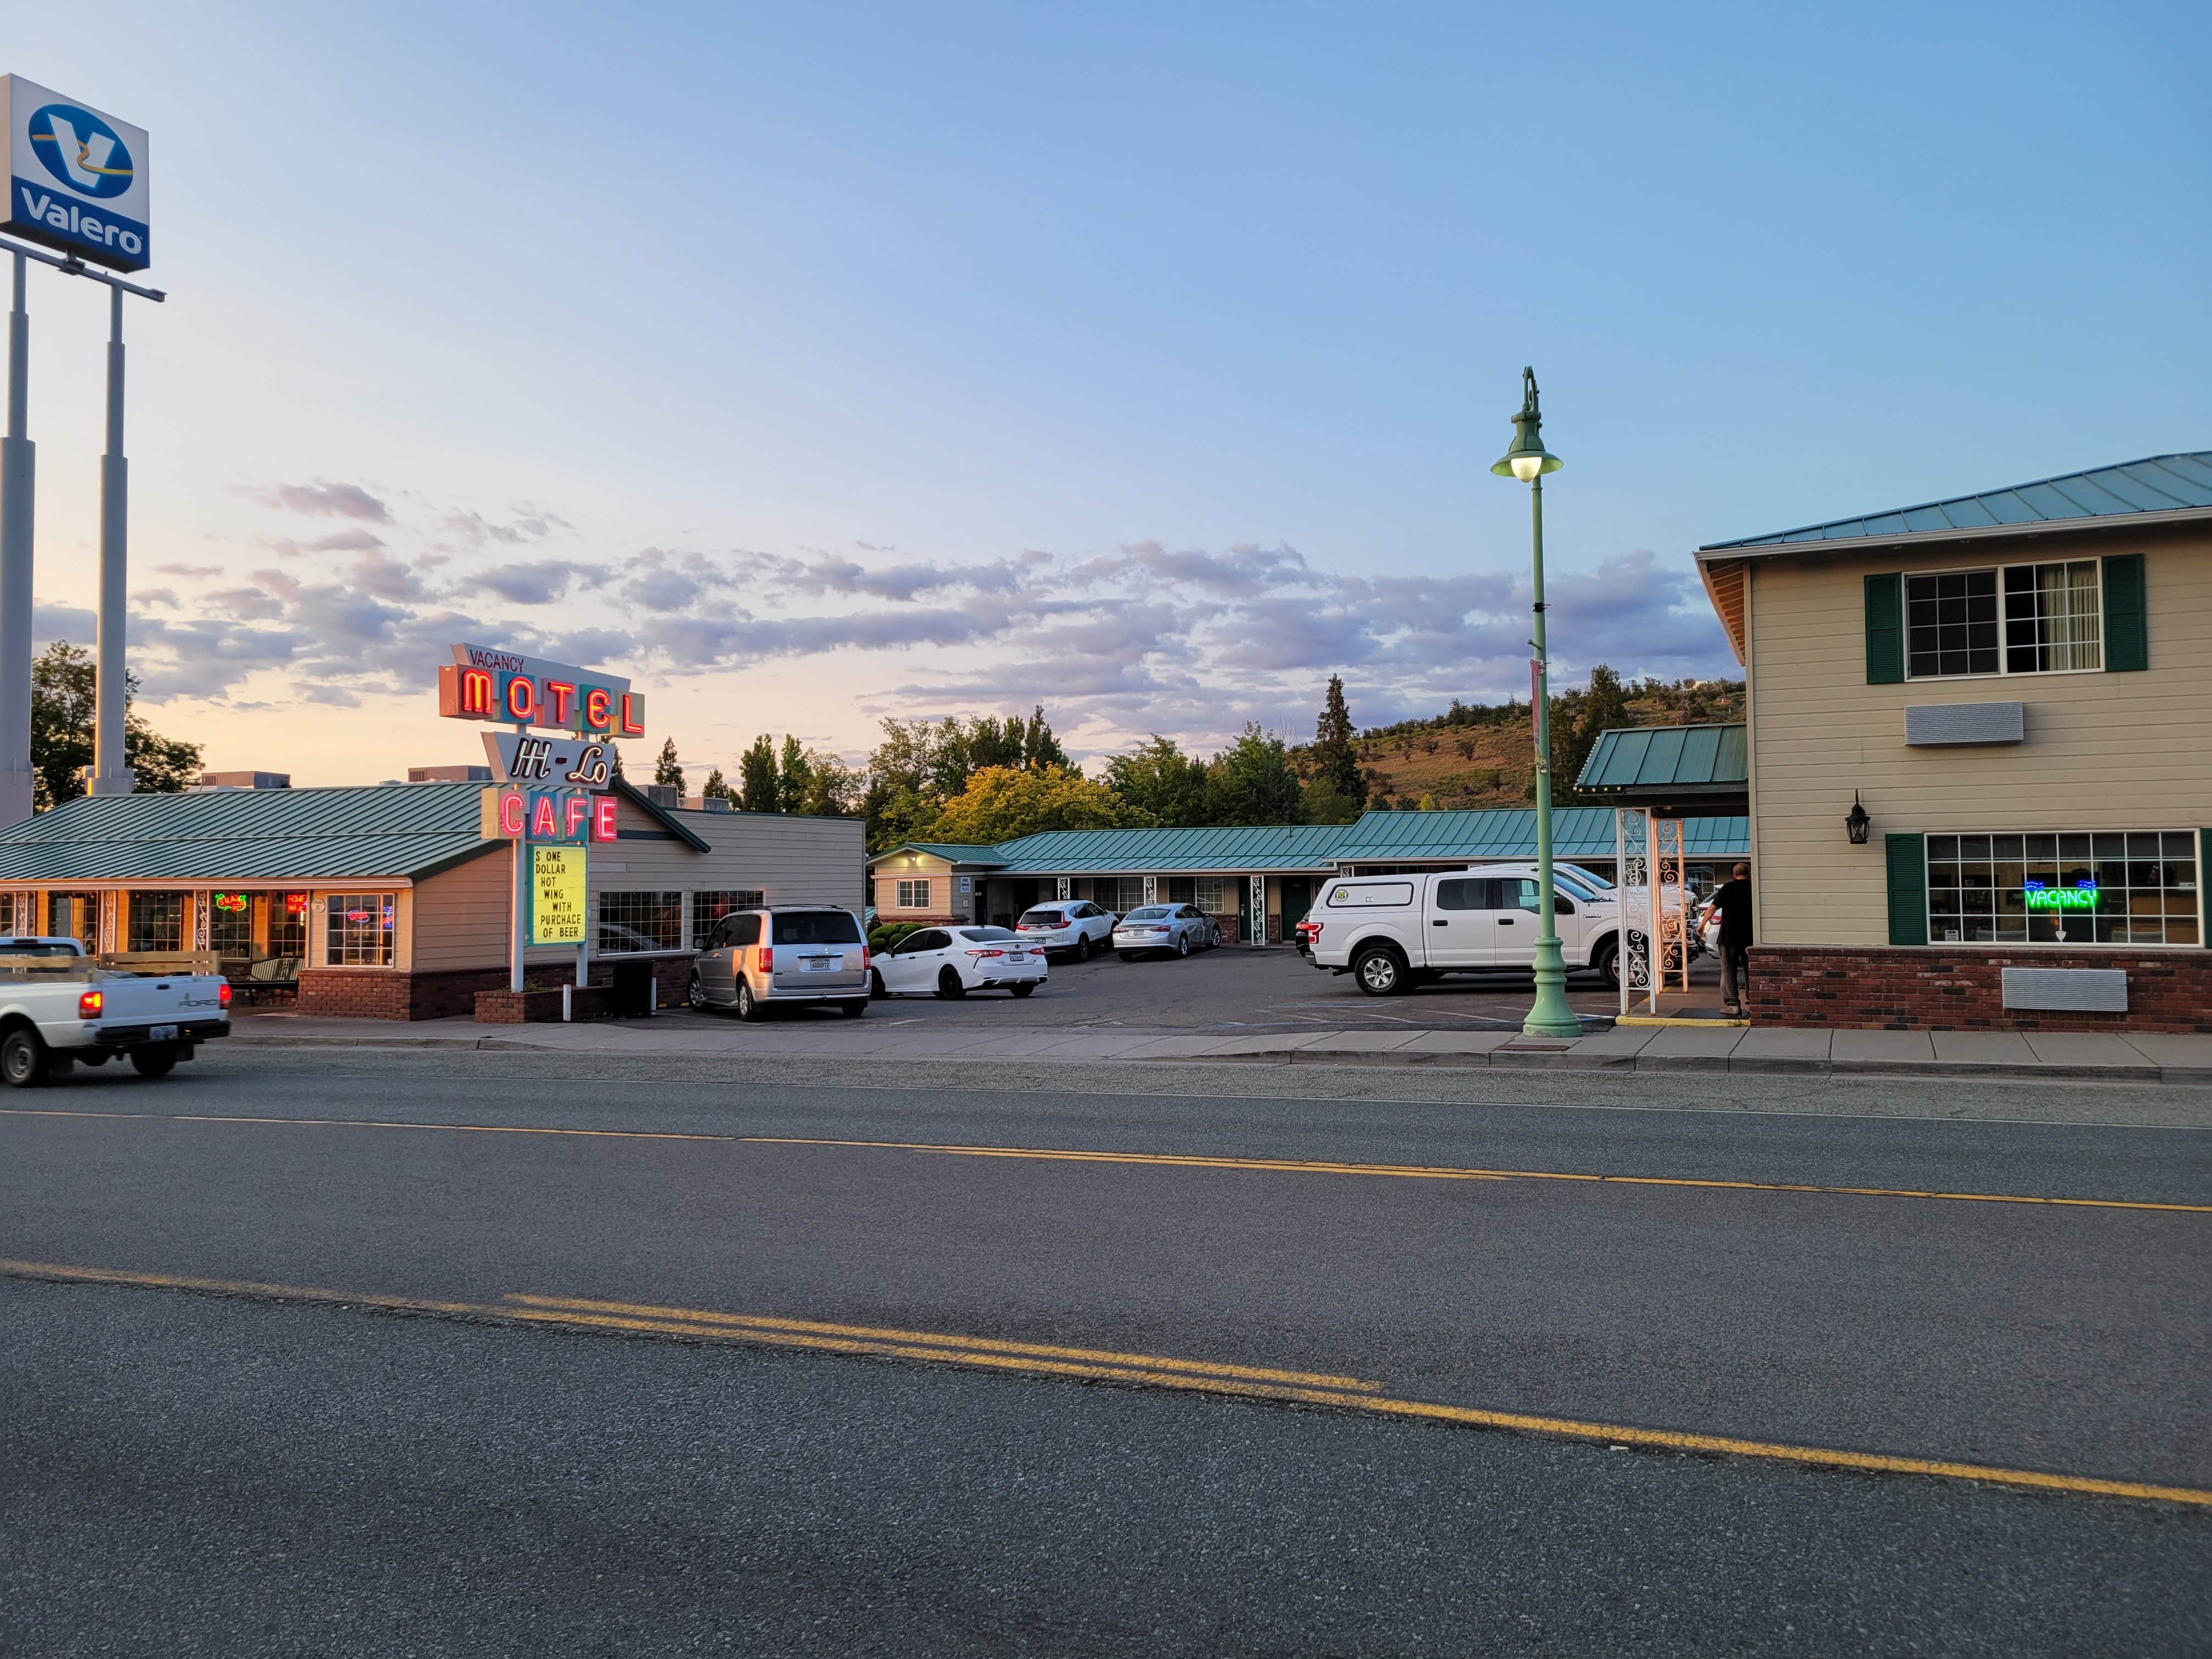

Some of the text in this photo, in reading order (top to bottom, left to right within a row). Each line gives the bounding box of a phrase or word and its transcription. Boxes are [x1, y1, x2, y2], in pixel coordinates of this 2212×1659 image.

[21, 187, 143, 255] Valero
[470, 649, 524, 673] VACANCY
[461, 668, 644, 734] MOTEL
[500, 793, 618, 842] CAFE
[535, 851, 561, 862] S ONE
[535, 864, 566, 874] DOLLAR
[541, 877, 556, 887] HOT
[544, 889, 563, 900] WING
[2026, 889, 2097, 905] VACANCY
[552, 901, 572, 912] WITH
[540, 914, 581, 926] PURCHACE
[543, 927, 578, 938] OF BEER
[178, 999, 218, 1008] FORD
